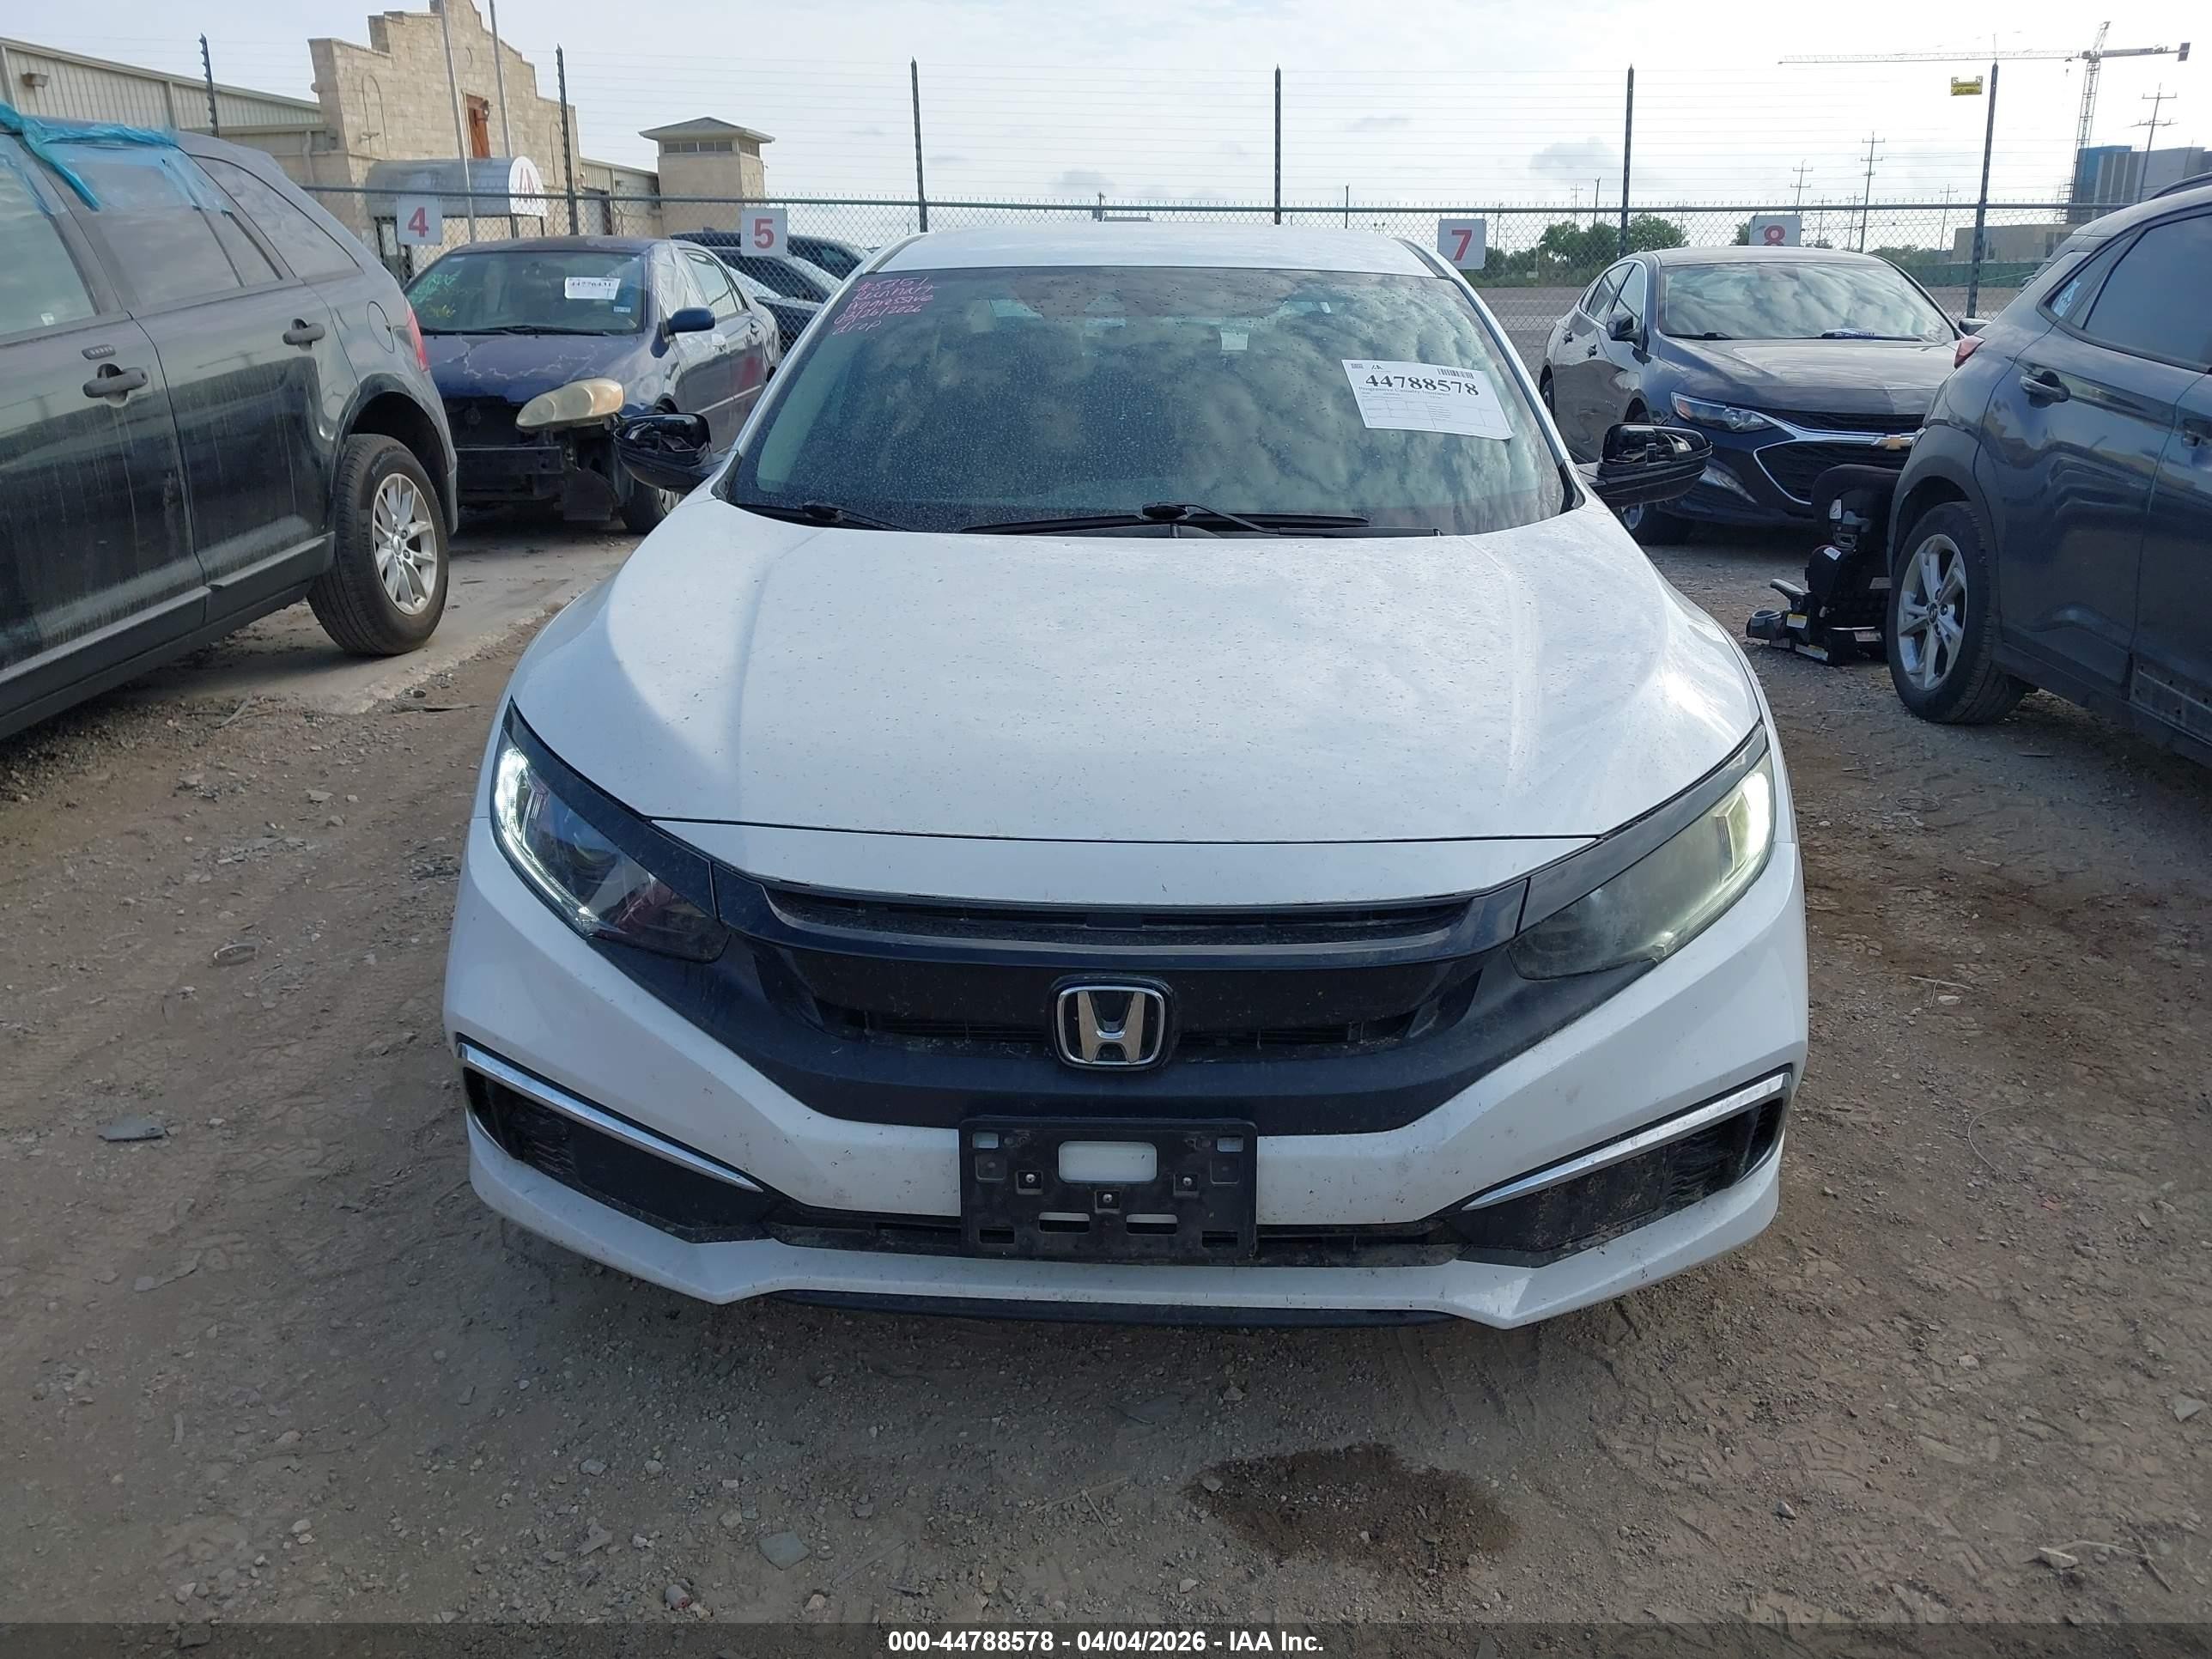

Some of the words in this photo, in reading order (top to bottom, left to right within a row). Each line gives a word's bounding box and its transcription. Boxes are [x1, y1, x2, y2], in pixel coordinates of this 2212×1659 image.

[408, 206, 429, 238] 4
[754, 218, 775, 249] 5
[1764, 224, 1786, 246] 8
[1451, 229, 1473, 261] 7
[831, 320, 882, 336] drop
[1365, 374, 1480, 396] 44788578
